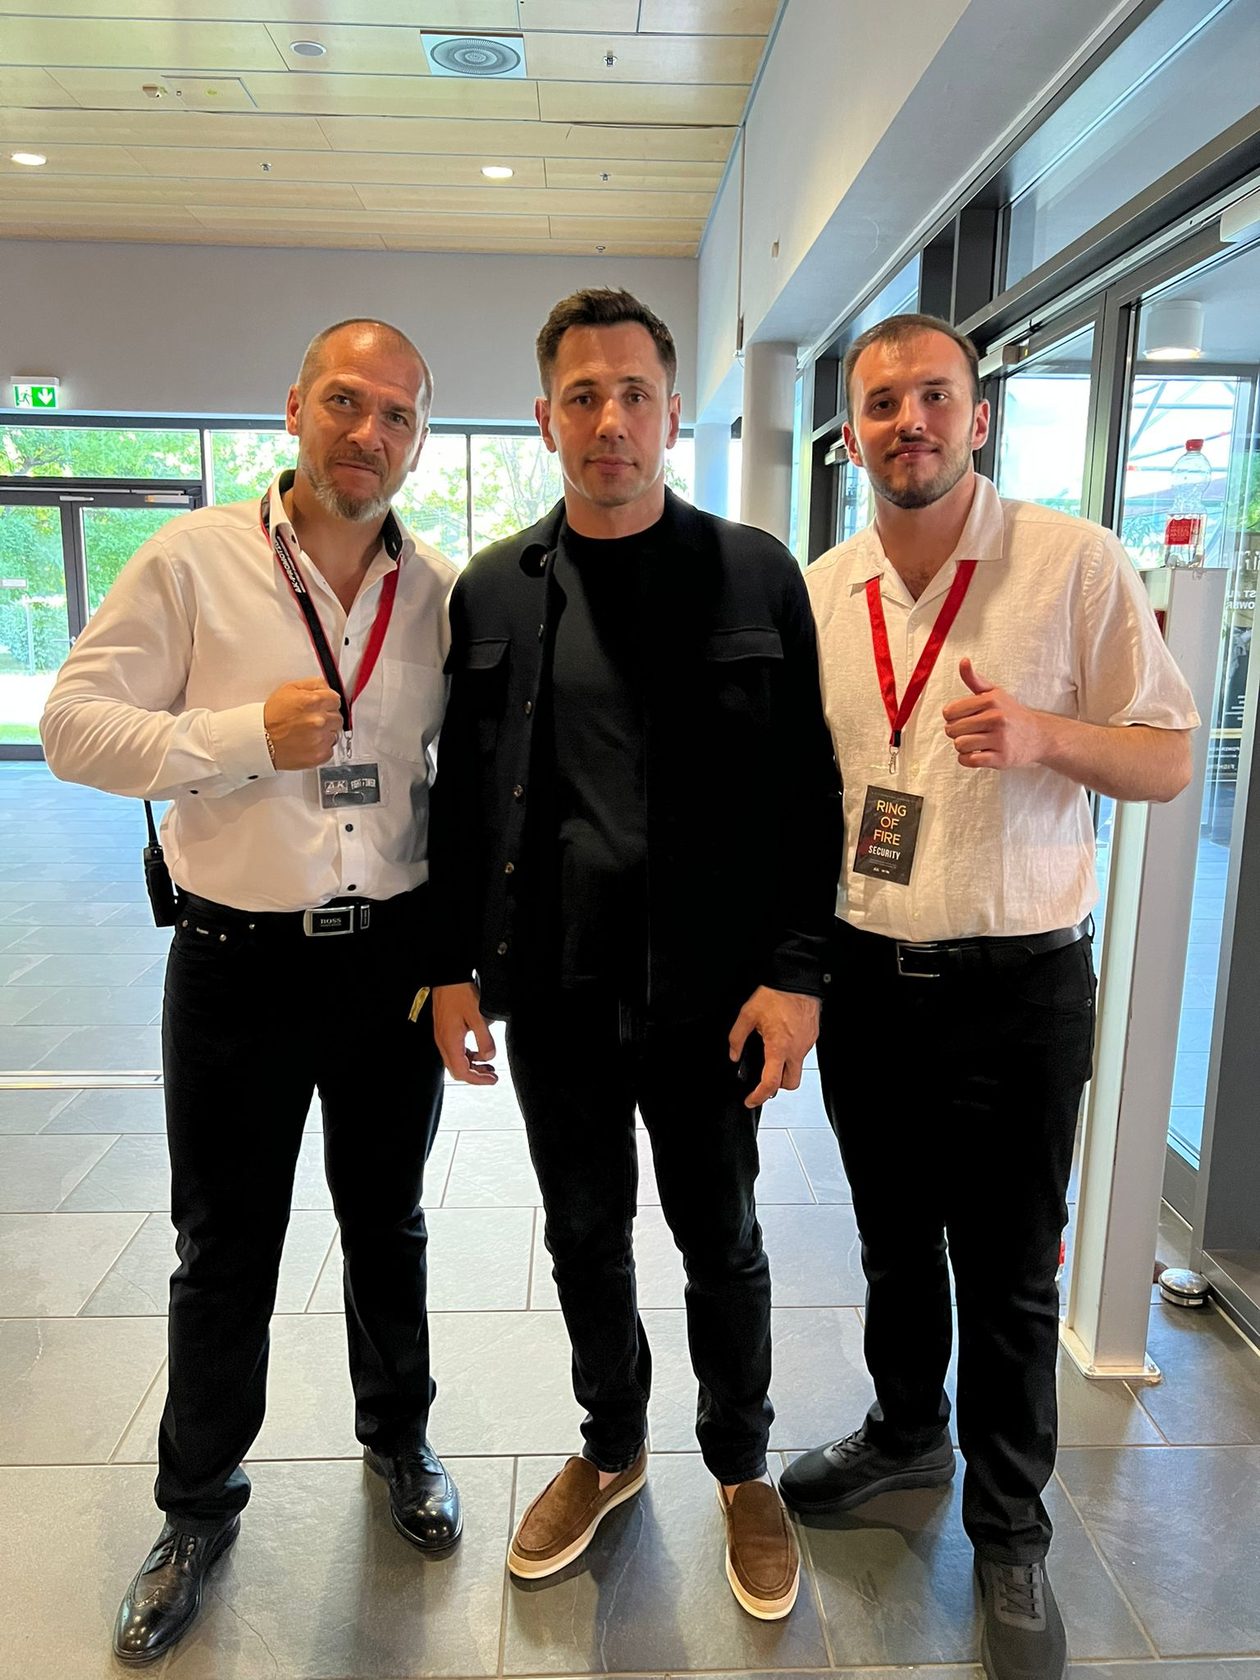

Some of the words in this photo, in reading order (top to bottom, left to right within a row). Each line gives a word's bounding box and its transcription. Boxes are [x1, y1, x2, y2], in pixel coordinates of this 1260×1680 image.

[876, 800, 907, 817] RING
[880, 816, 900, 830] OF
[873, 829, 901, 846] FIRE
[868, 845, 901, 861] SECURITY
